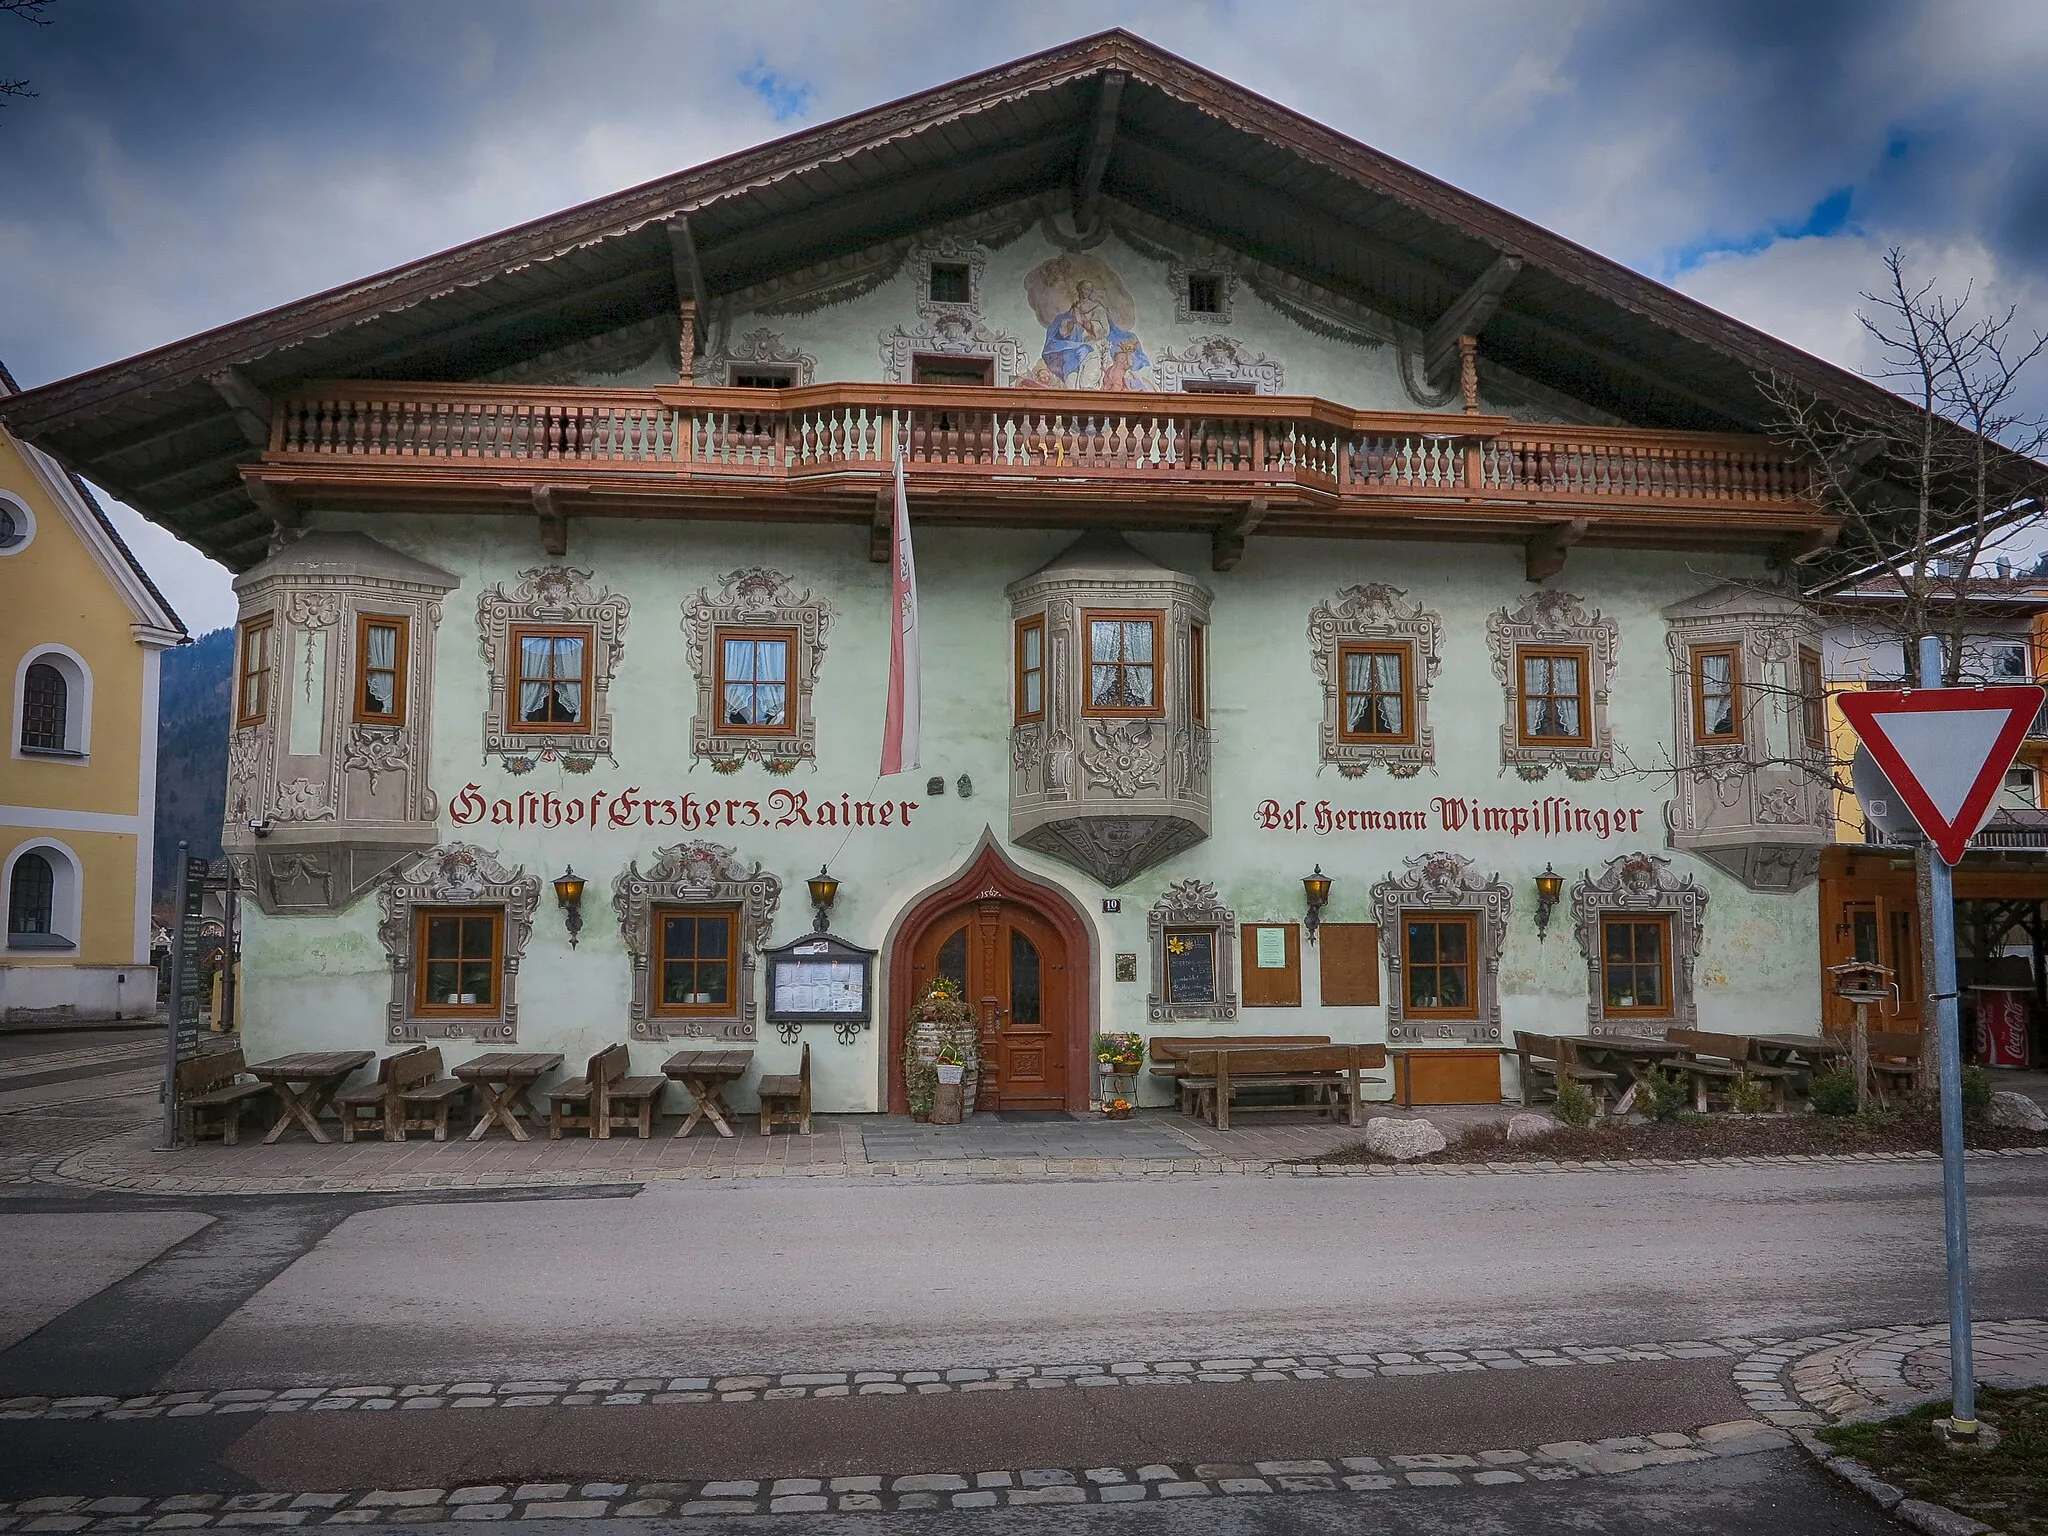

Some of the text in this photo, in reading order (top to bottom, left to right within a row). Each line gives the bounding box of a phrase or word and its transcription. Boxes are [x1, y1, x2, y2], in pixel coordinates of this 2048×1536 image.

[449, 782, 607, 831] Gasthof
[768, 788, 920, 829] Rainer
[1314, 800, 1427, 836] Hermann
[1430, 796, 1645, 840] Wimpissinger
[1106, 899, 1117, 909] 10
[2004, 1002, 2025, 1059] Coca-Cola
